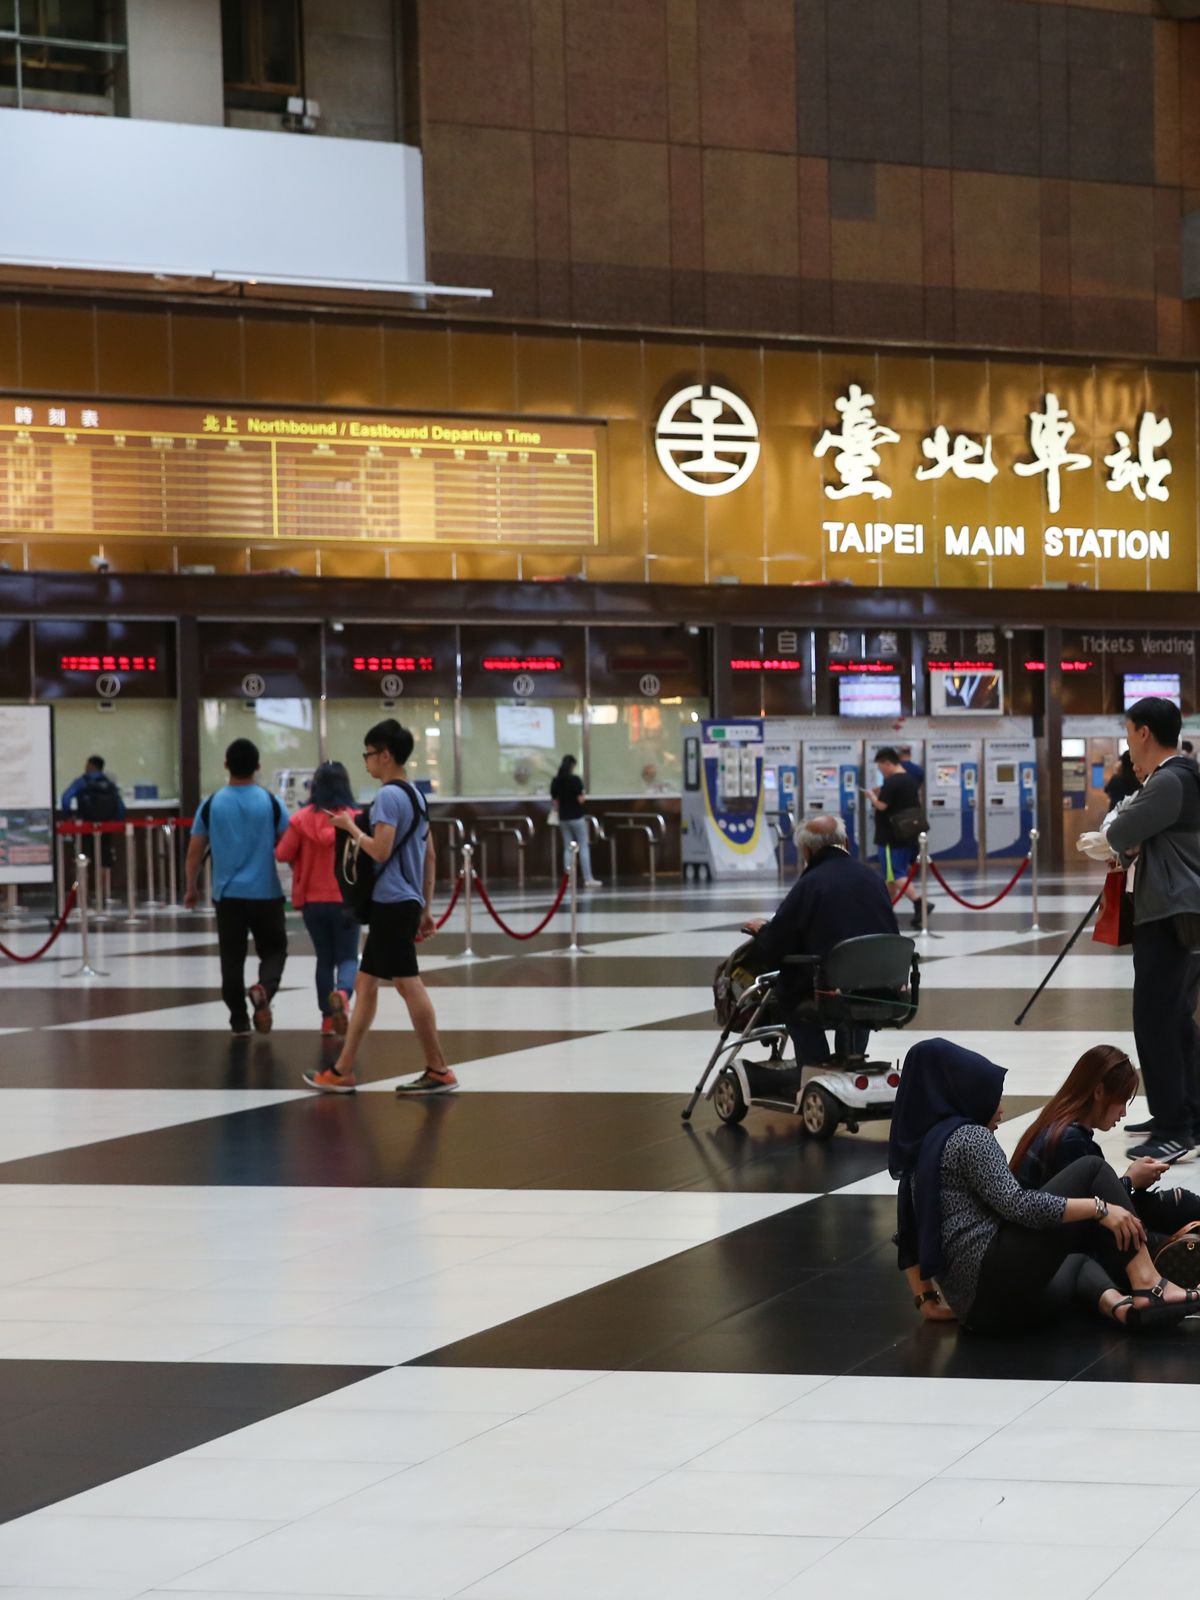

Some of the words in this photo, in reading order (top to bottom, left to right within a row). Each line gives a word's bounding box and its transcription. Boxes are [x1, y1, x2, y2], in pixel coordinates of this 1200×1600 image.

[14, 406, 99, 428] 時刻表
[203, 414, 239, 433] 北上
[247, 417, 337, 436] Northbound
[350, 422, 429, 440] Eastbound
[432, 425, 502, 443] Departure
[506, 429, 541, 445] Time
[813, 384, 1173, 513] 臺北車站
[822, 521, 924, 555] TAIPEI
[945, 525, 1025, 556] MAIN
[1044, 527, 1171, 560] STATION
[1081, 636, 1134, 653] Tickets
[1141, 637, 1195, 655] Vending
